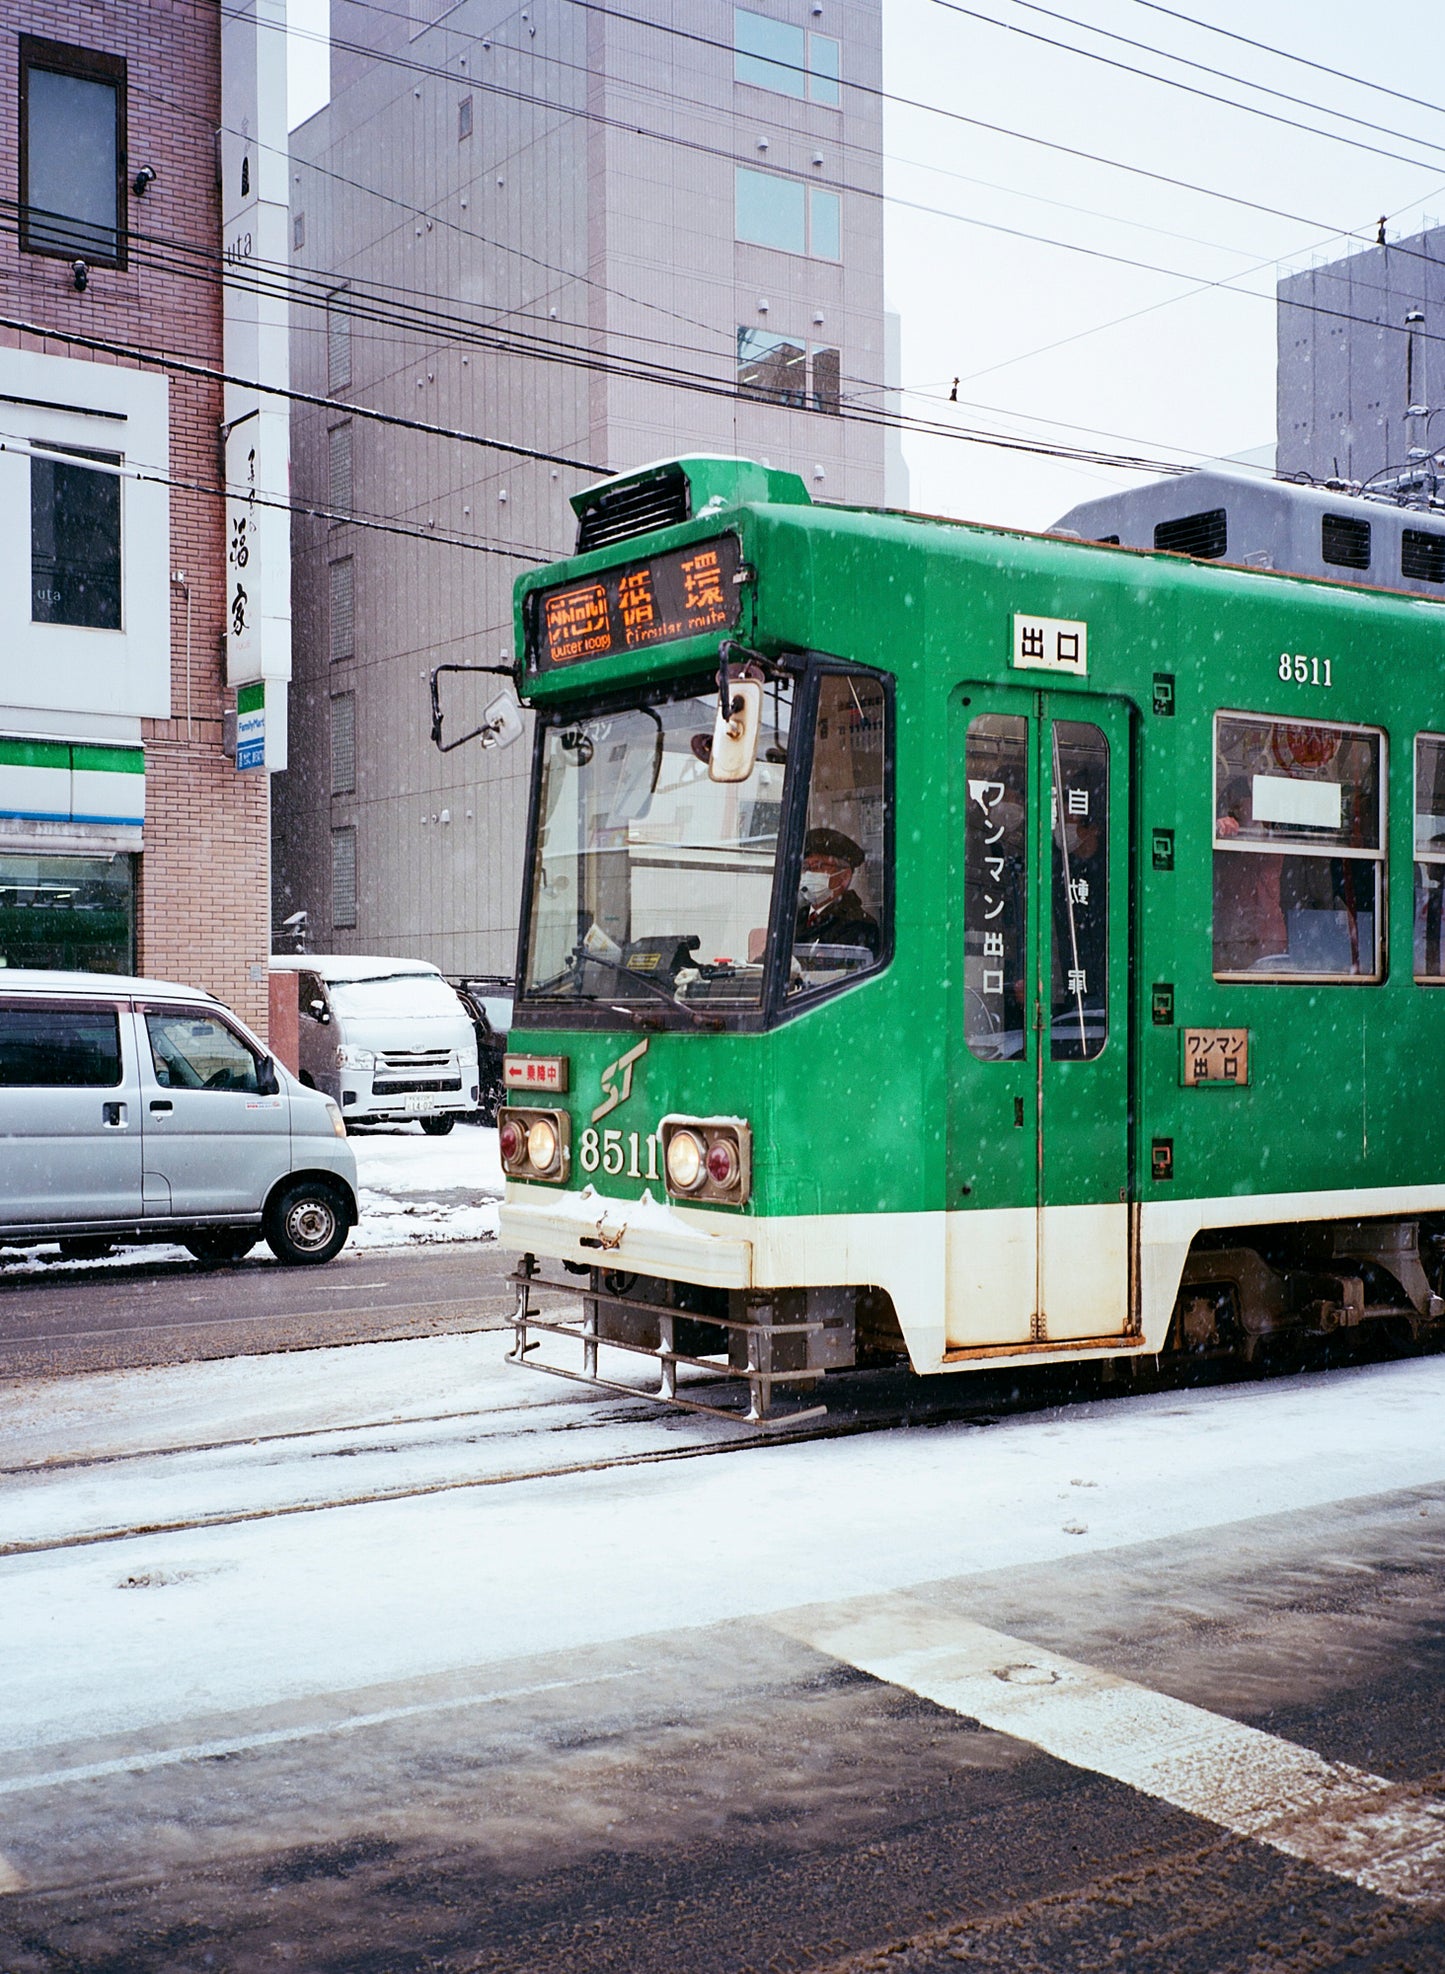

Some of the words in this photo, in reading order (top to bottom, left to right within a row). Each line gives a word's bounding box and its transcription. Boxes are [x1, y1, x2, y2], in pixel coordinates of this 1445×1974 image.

[227, 232, 252, 266] uta
[37, 589, 61, 602] uta
[1021, 627, 1079, 662] 出口
[1279, 652, 1332, 687] 8511
[1188, 1036, 1244, 1055] ワンマン
[1193, 1057, 1238, 1079] 出口
[580, 1127, 660, 1180] 8511
